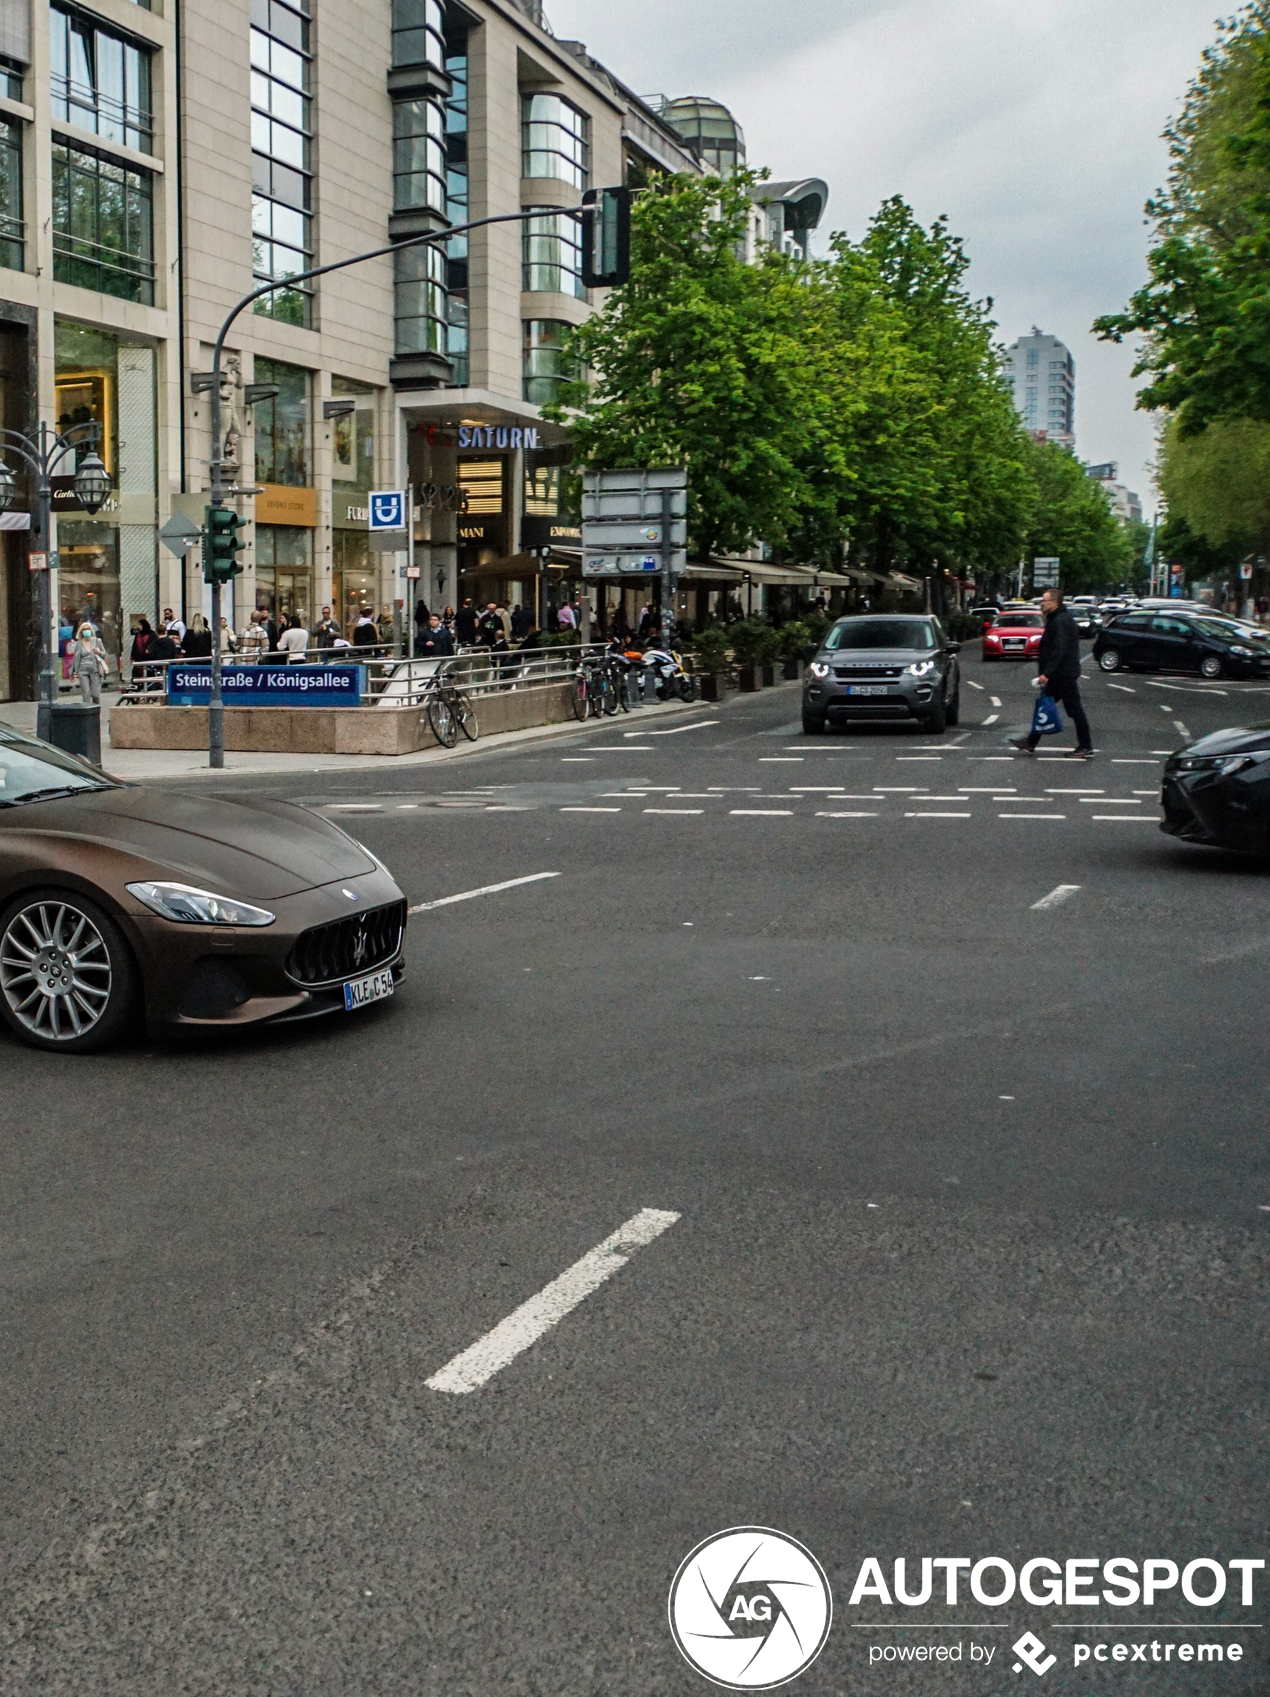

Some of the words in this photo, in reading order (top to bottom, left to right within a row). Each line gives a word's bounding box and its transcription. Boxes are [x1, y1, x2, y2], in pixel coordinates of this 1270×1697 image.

[458, 426, 538, 449] SATURN
[459, 527, 484, 538] MANI
[257, 673, 264, 687] /
[267, 673, 350, 690] Königsallee
[351, 981, 370, 1006] KLE
[373, 976, 381, 996] C
